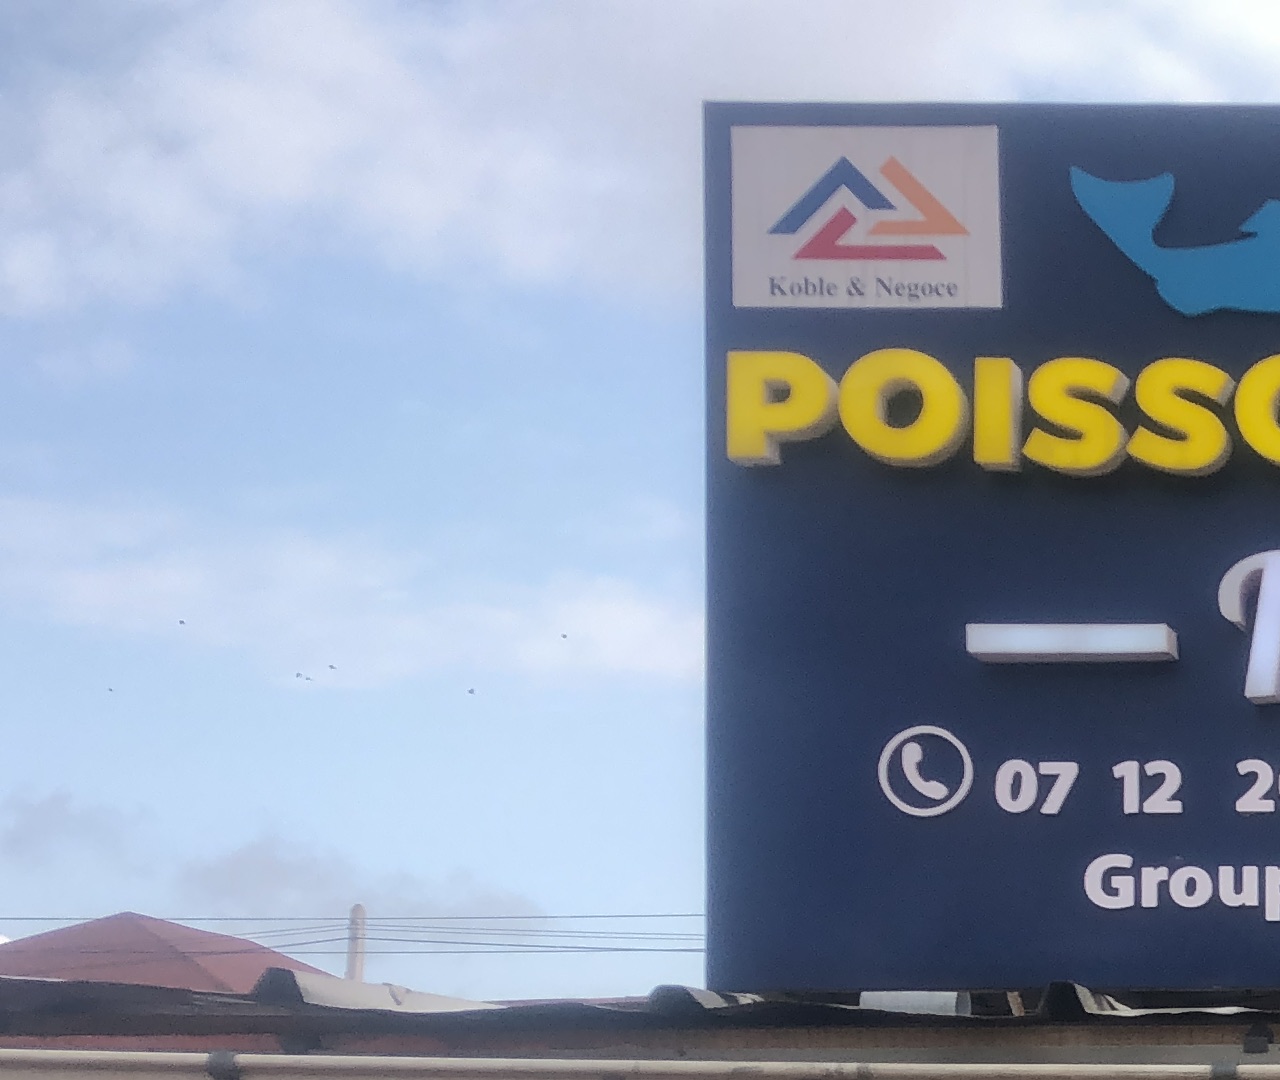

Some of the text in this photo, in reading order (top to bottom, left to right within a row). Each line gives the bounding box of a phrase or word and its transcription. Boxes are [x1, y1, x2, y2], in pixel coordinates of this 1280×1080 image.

[768, 276, 959, 303] Koble & Negoce
[994, 759, 1080, 815] 07
[1112, 759, 1184, 814] 12
